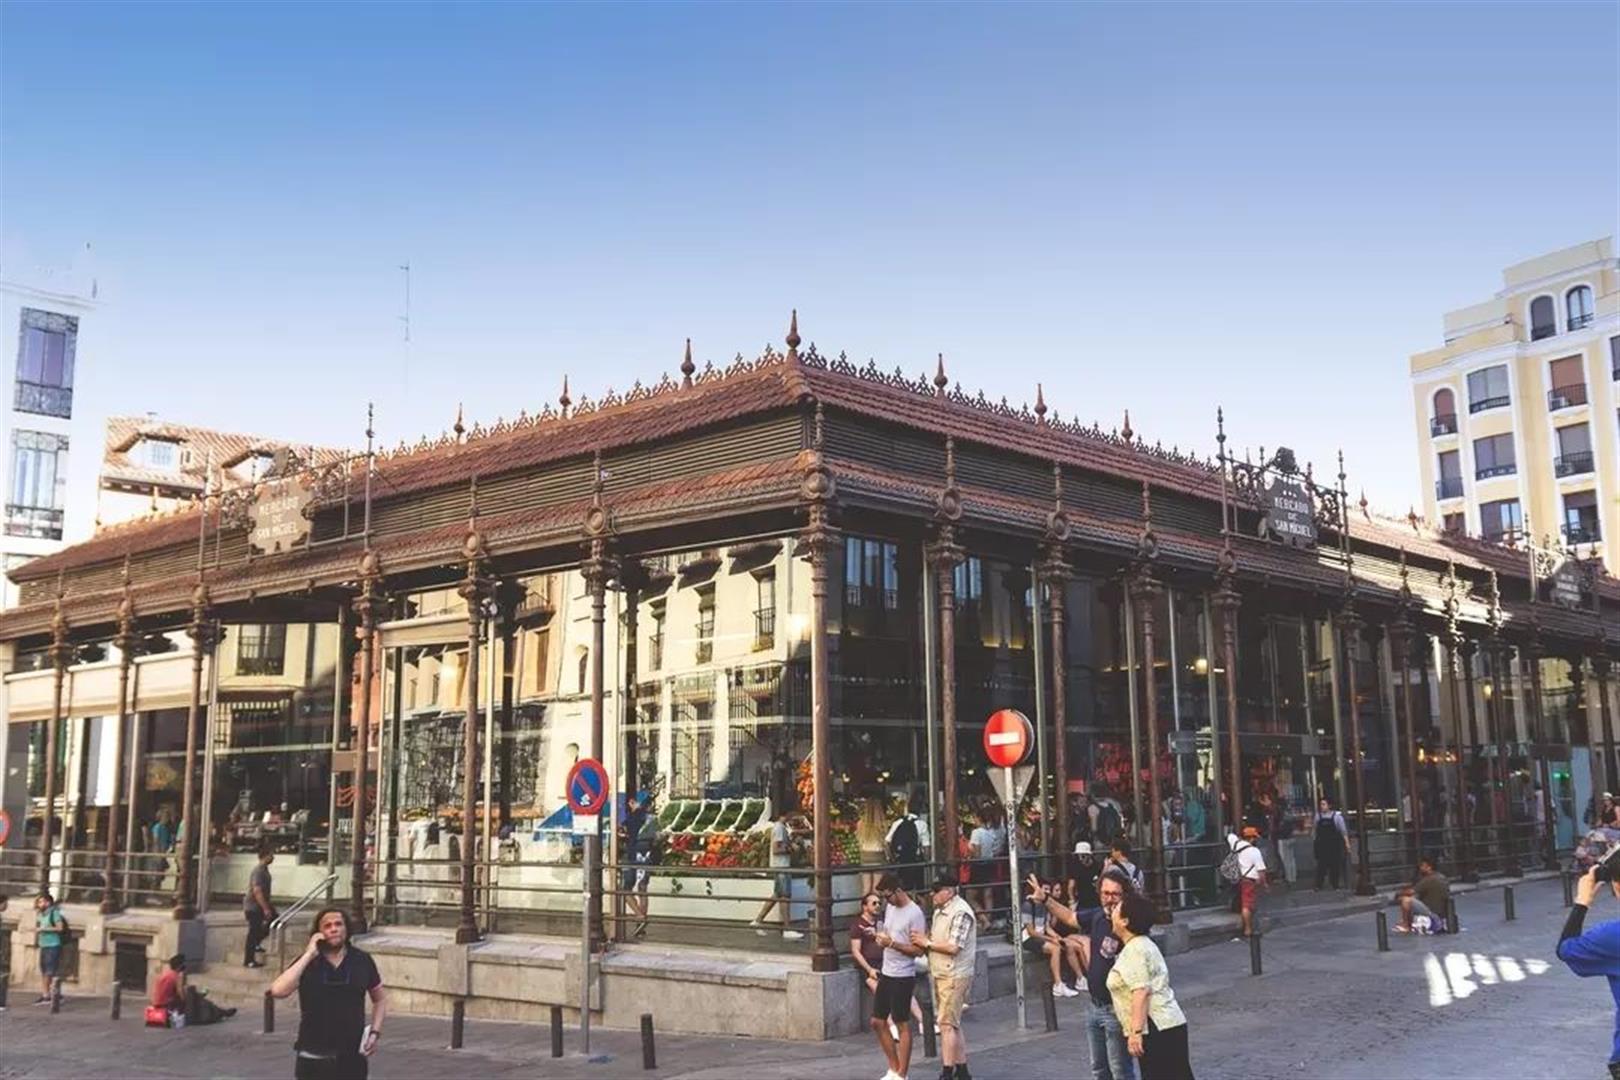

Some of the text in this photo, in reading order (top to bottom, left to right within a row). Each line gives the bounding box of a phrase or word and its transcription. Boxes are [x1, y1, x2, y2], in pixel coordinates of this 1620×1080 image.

[1274, 497, 1309, 514] MERCADO
[1275, 519, 1313, 538] SAN MIGUEL
